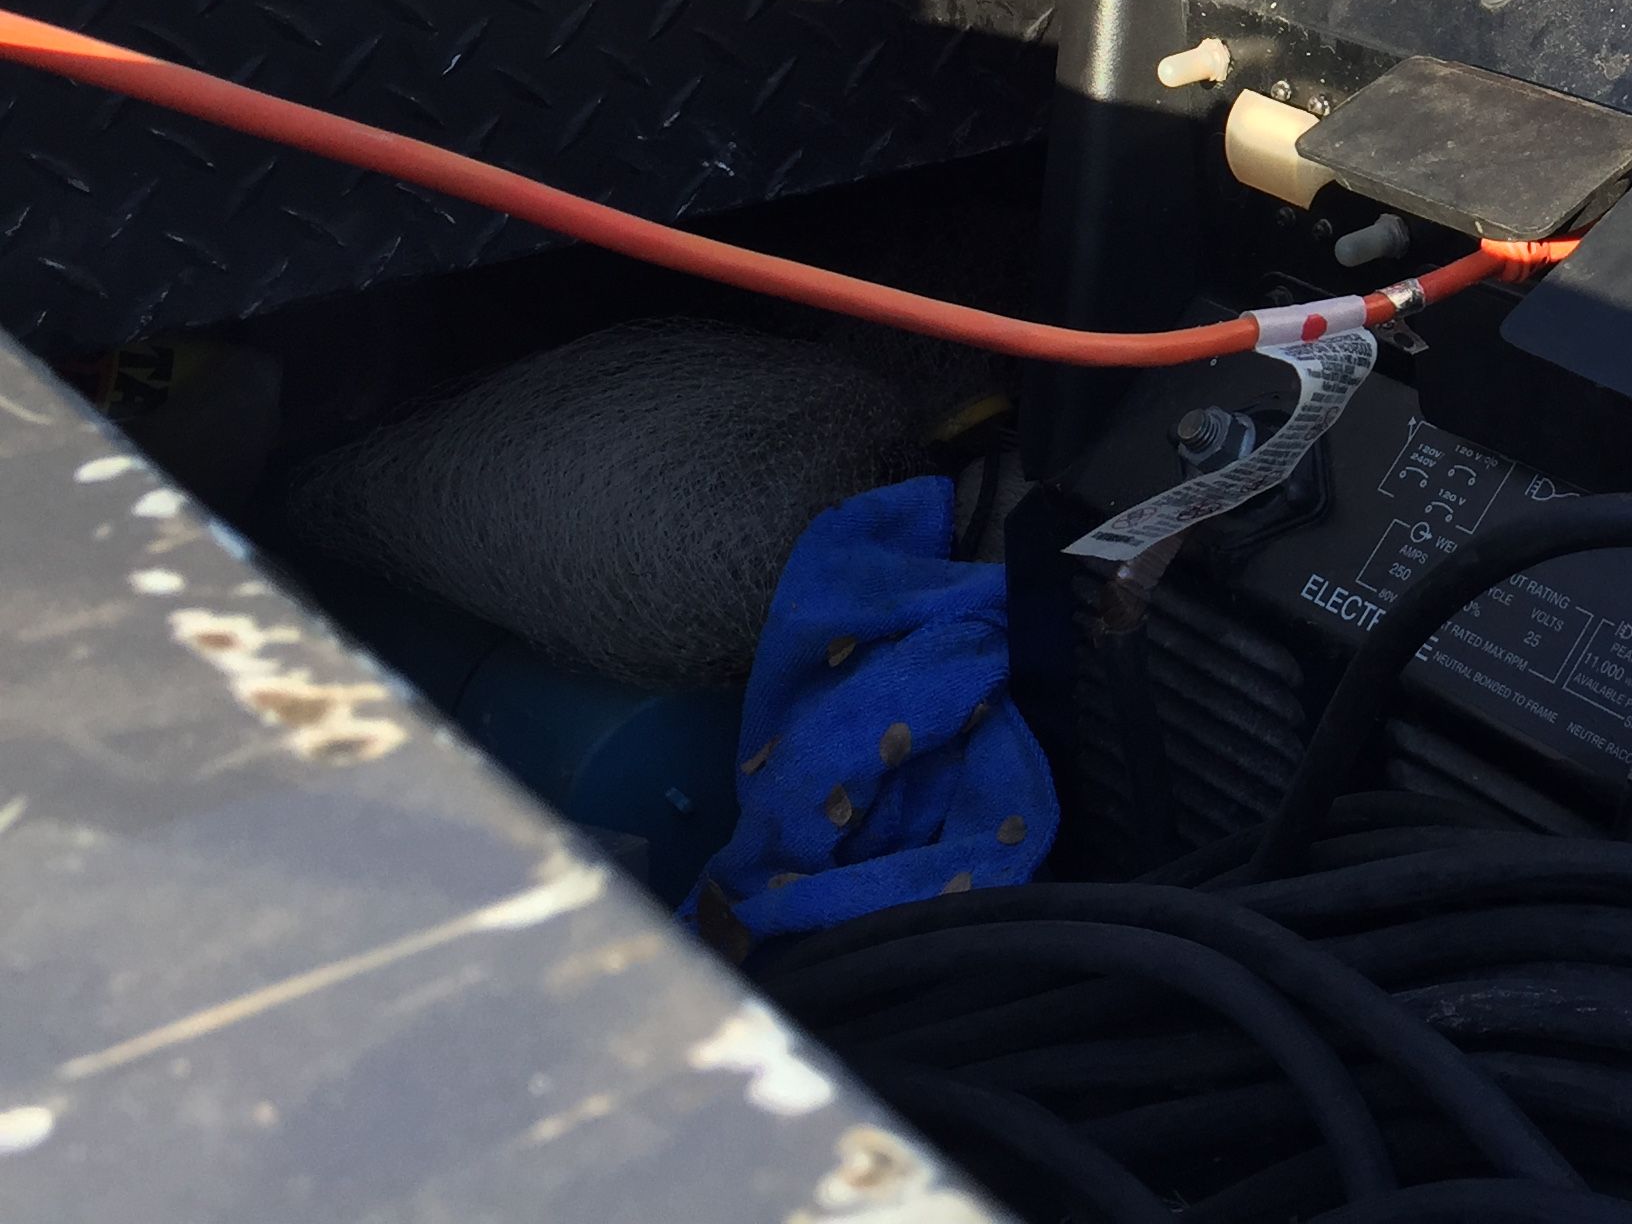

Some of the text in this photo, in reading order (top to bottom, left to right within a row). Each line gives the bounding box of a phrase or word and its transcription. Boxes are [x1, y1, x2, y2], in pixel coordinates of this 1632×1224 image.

[1410, 452, 1437, 468] 240V
[1455, 444, 1474, 457] 120
[1438, 488, 1467, 506] 120 V
[1399, 543, 1429, 565] AMPS
[1388, 562, 1412, 582] 250
[1526, 576, 1571, 610] RATING
[1529, 606, 1566, 634] VOLTS
[1449, 623, 1484, 650] RATED
[1481, 639, 1506, 663] MAX
[1504, 651, 1529, 674] RPM
[1522, 630, 1542, 649] 25
[1583, 651, 1626, 682] 11,000
[1432, 649, 1560, 725] NEUTRAL BONDED TO FRAME
[1572, 672, 1624, 707] AVAILABLE
[1565, 721, 1607, 751] NEUTRE
